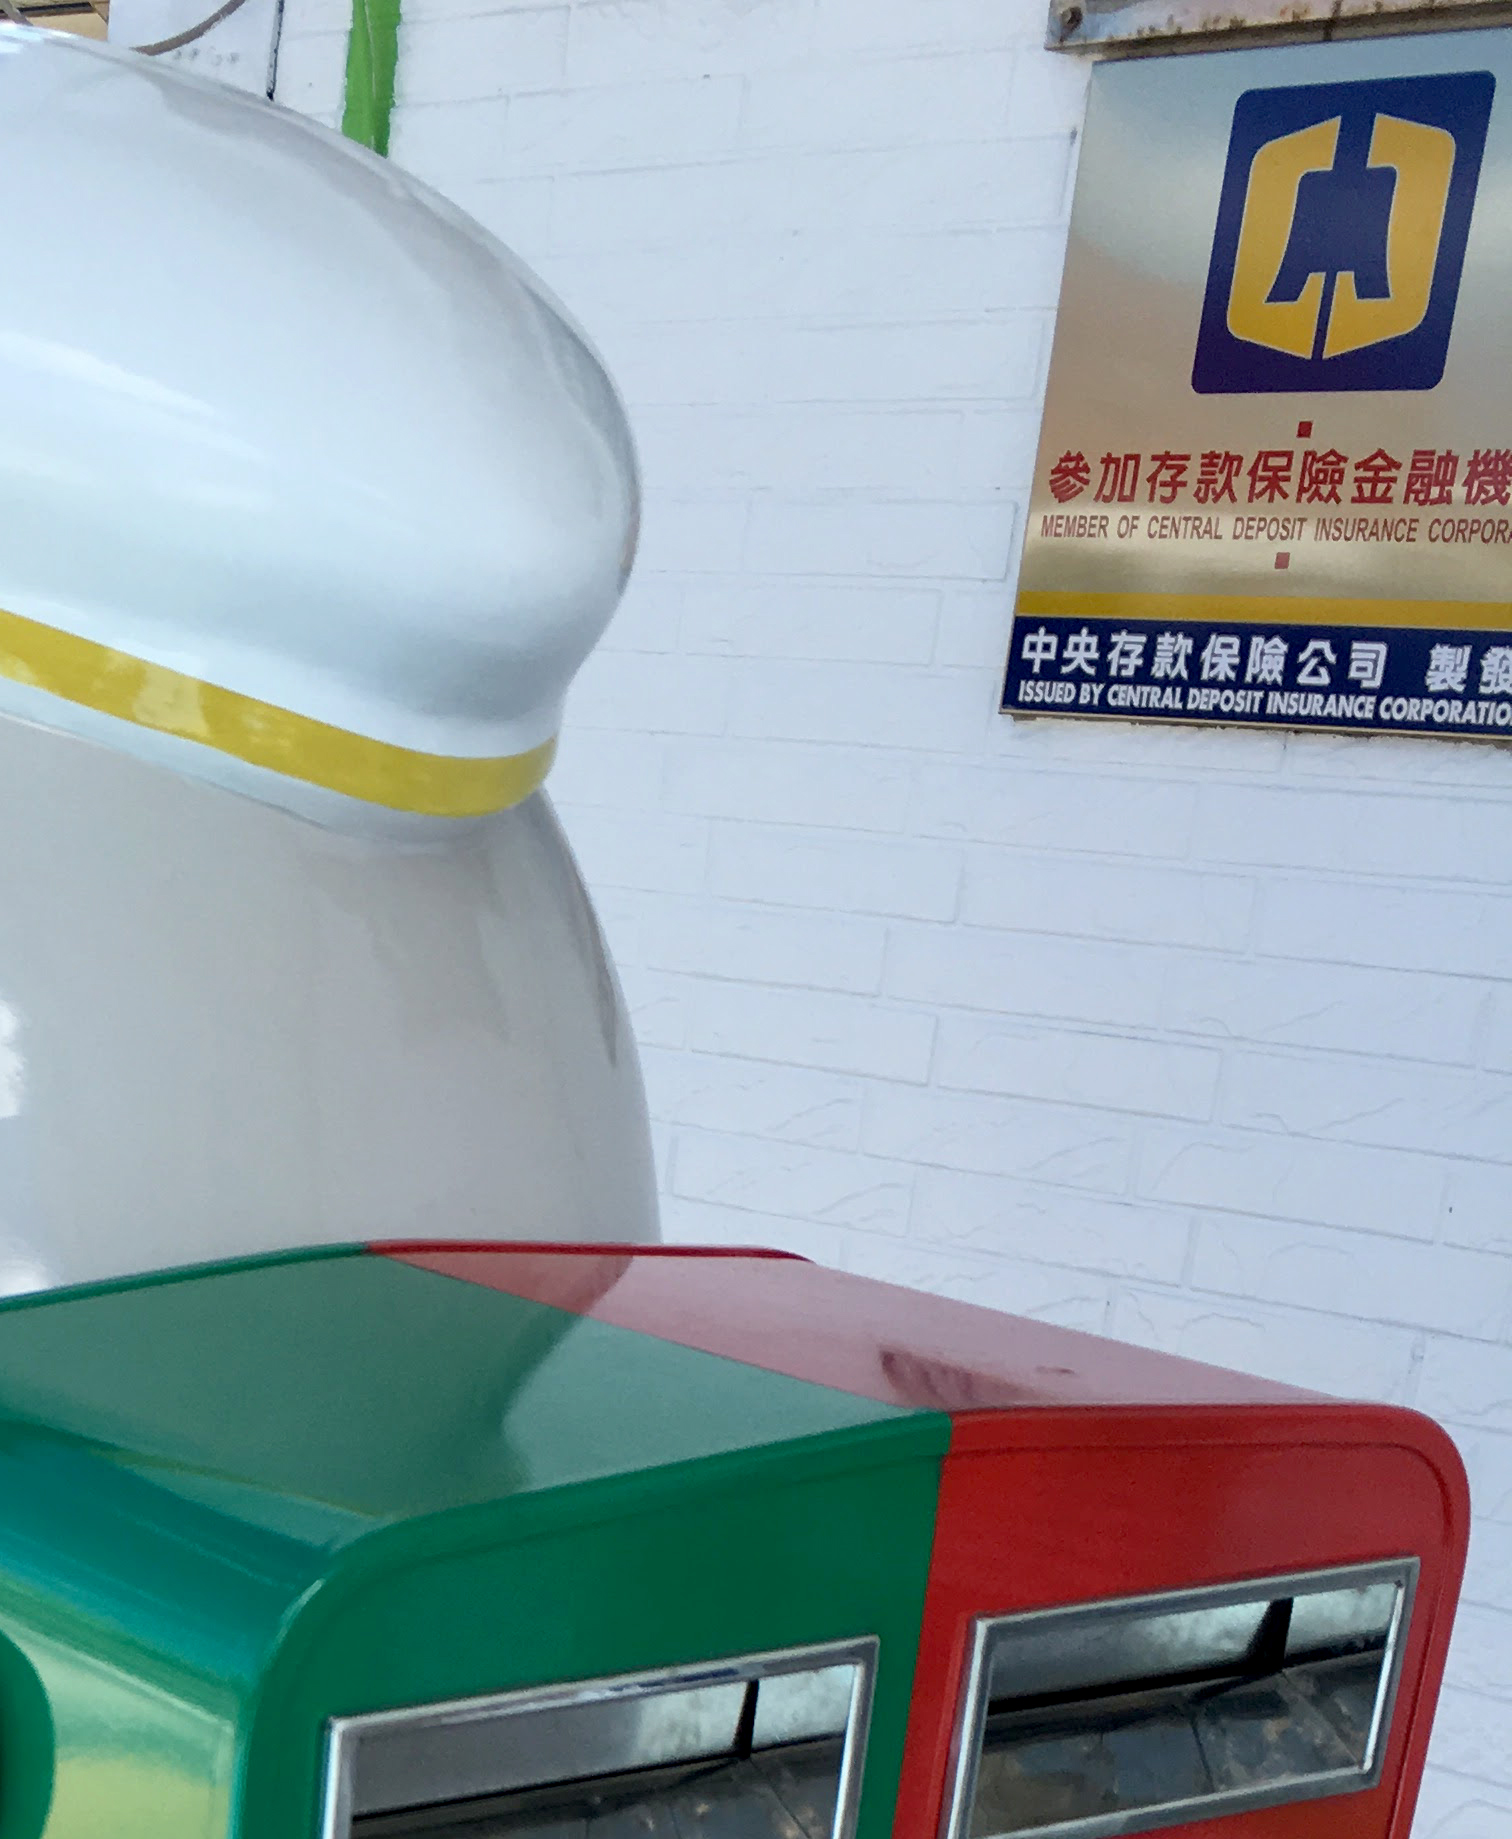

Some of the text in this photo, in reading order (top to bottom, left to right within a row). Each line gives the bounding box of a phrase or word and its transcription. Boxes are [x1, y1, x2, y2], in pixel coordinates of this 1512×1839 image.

[1048, 447, 1512, 506] 參加存款保險金融機
[1041, 515, 1109, 539] MEMBER
[1117, 515, 1140, 539] OF
[1147, 516, 1224, 541] CENTRAL
[1232, 517, 1308, 542] DEPOSIT
[1315, 518, 1418, 543] INSURANCE
[1021, 626, 1388, 689] 中央存款保險公司
[1018, 679, 1075, 704] ISSUED
[1079, 682, 1105, 706] BY
[1106, 684, 1185, 711] CENTRAL
[1186, 688, 1262, 715] DEPOSIT
[1265, 691, 1375, 720] INSURANCE
